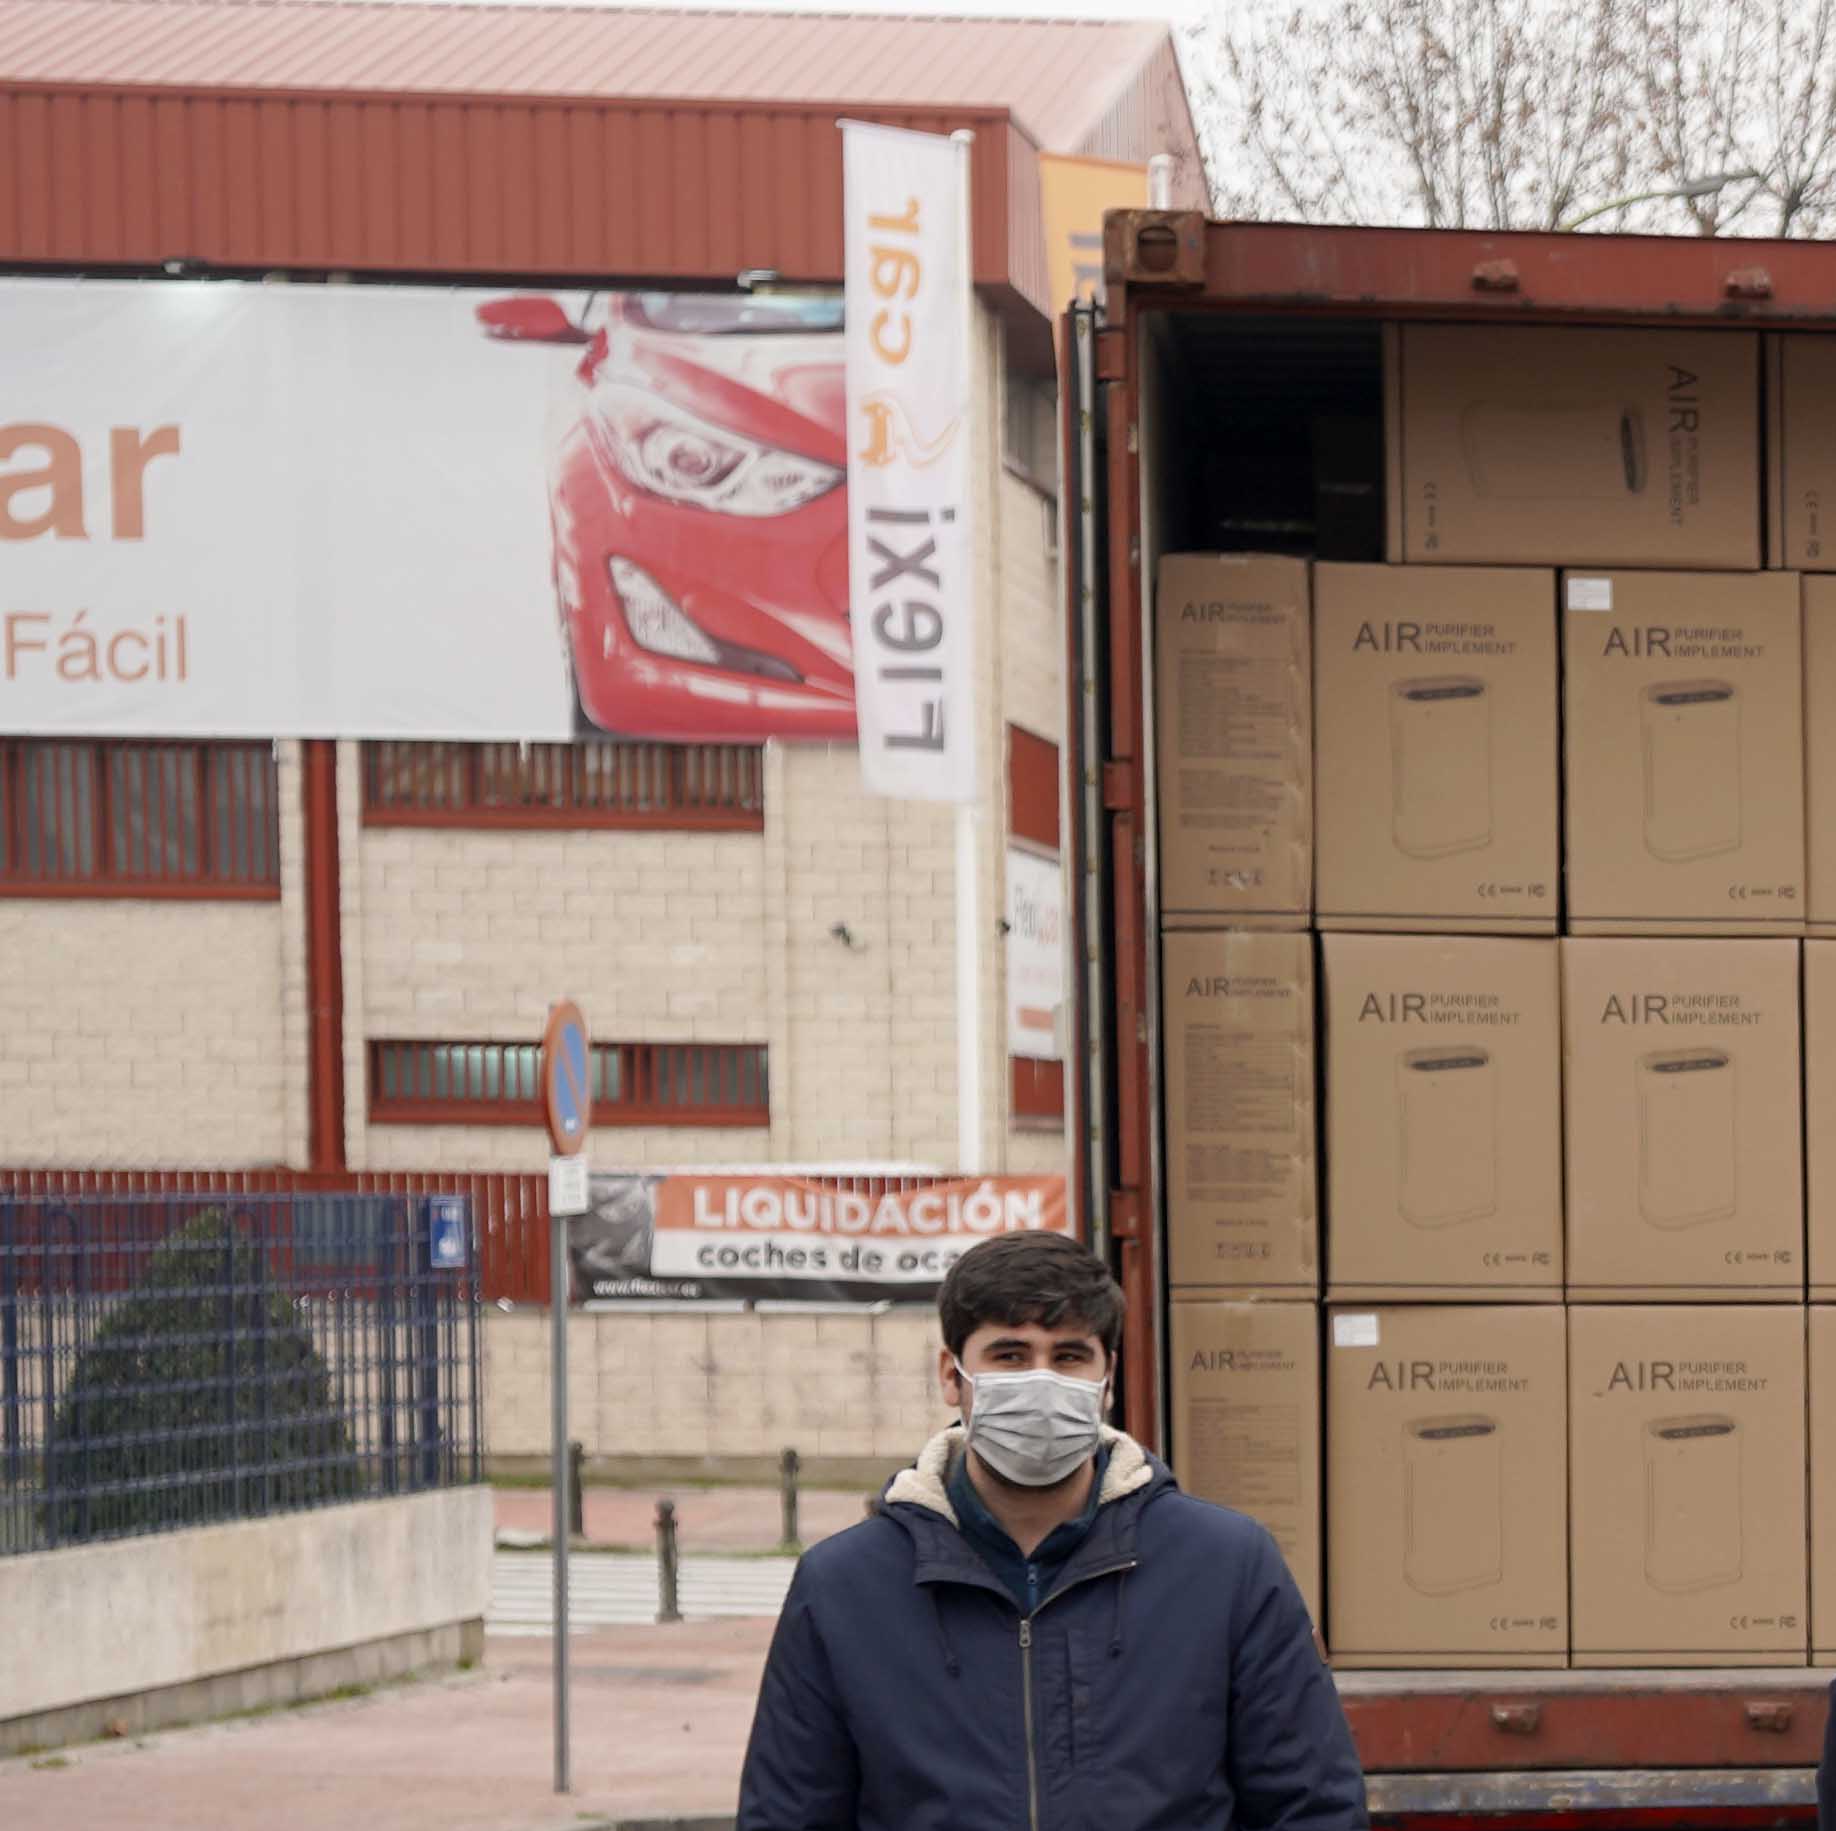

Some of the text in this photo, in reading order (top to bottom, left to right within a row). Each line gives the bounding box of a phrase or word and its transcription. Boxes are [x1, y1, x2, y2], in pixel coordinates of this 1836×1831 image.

[1667, 366, 1698, 433] AIR
[0, 424, 178, 542] ar
[1180, 601, 1225, 624] AIR
[5, 608, 188, 683] Fácil
[1353, 621, 1423, 653] AIR
[1603, 627, 1672, 657] AIR
[1185, 976, 1231, 997] AIR
[1358, 993, 1499, 1023] AIR PURIFIER
[1428, 1010, 1520, 1025] IMPLEMENT
[1601, 994, 1670, 1024] AIR
[694, 1184, 1042, 1233] LIQUIDACIÓN
[698, 1242, 956, 1272] coches de oca
[1189, 1348, 1236, 1372] AIR
[1367, 1360, 1508, 1391] AIR PURIFIER
[1438, 1377, 1528, 1392] IMPLEMENT
[1608, 1361, 1747, 1391] AIR PURIFIER
[1678, 1376, 1768, 1392] IMPLEMENT
